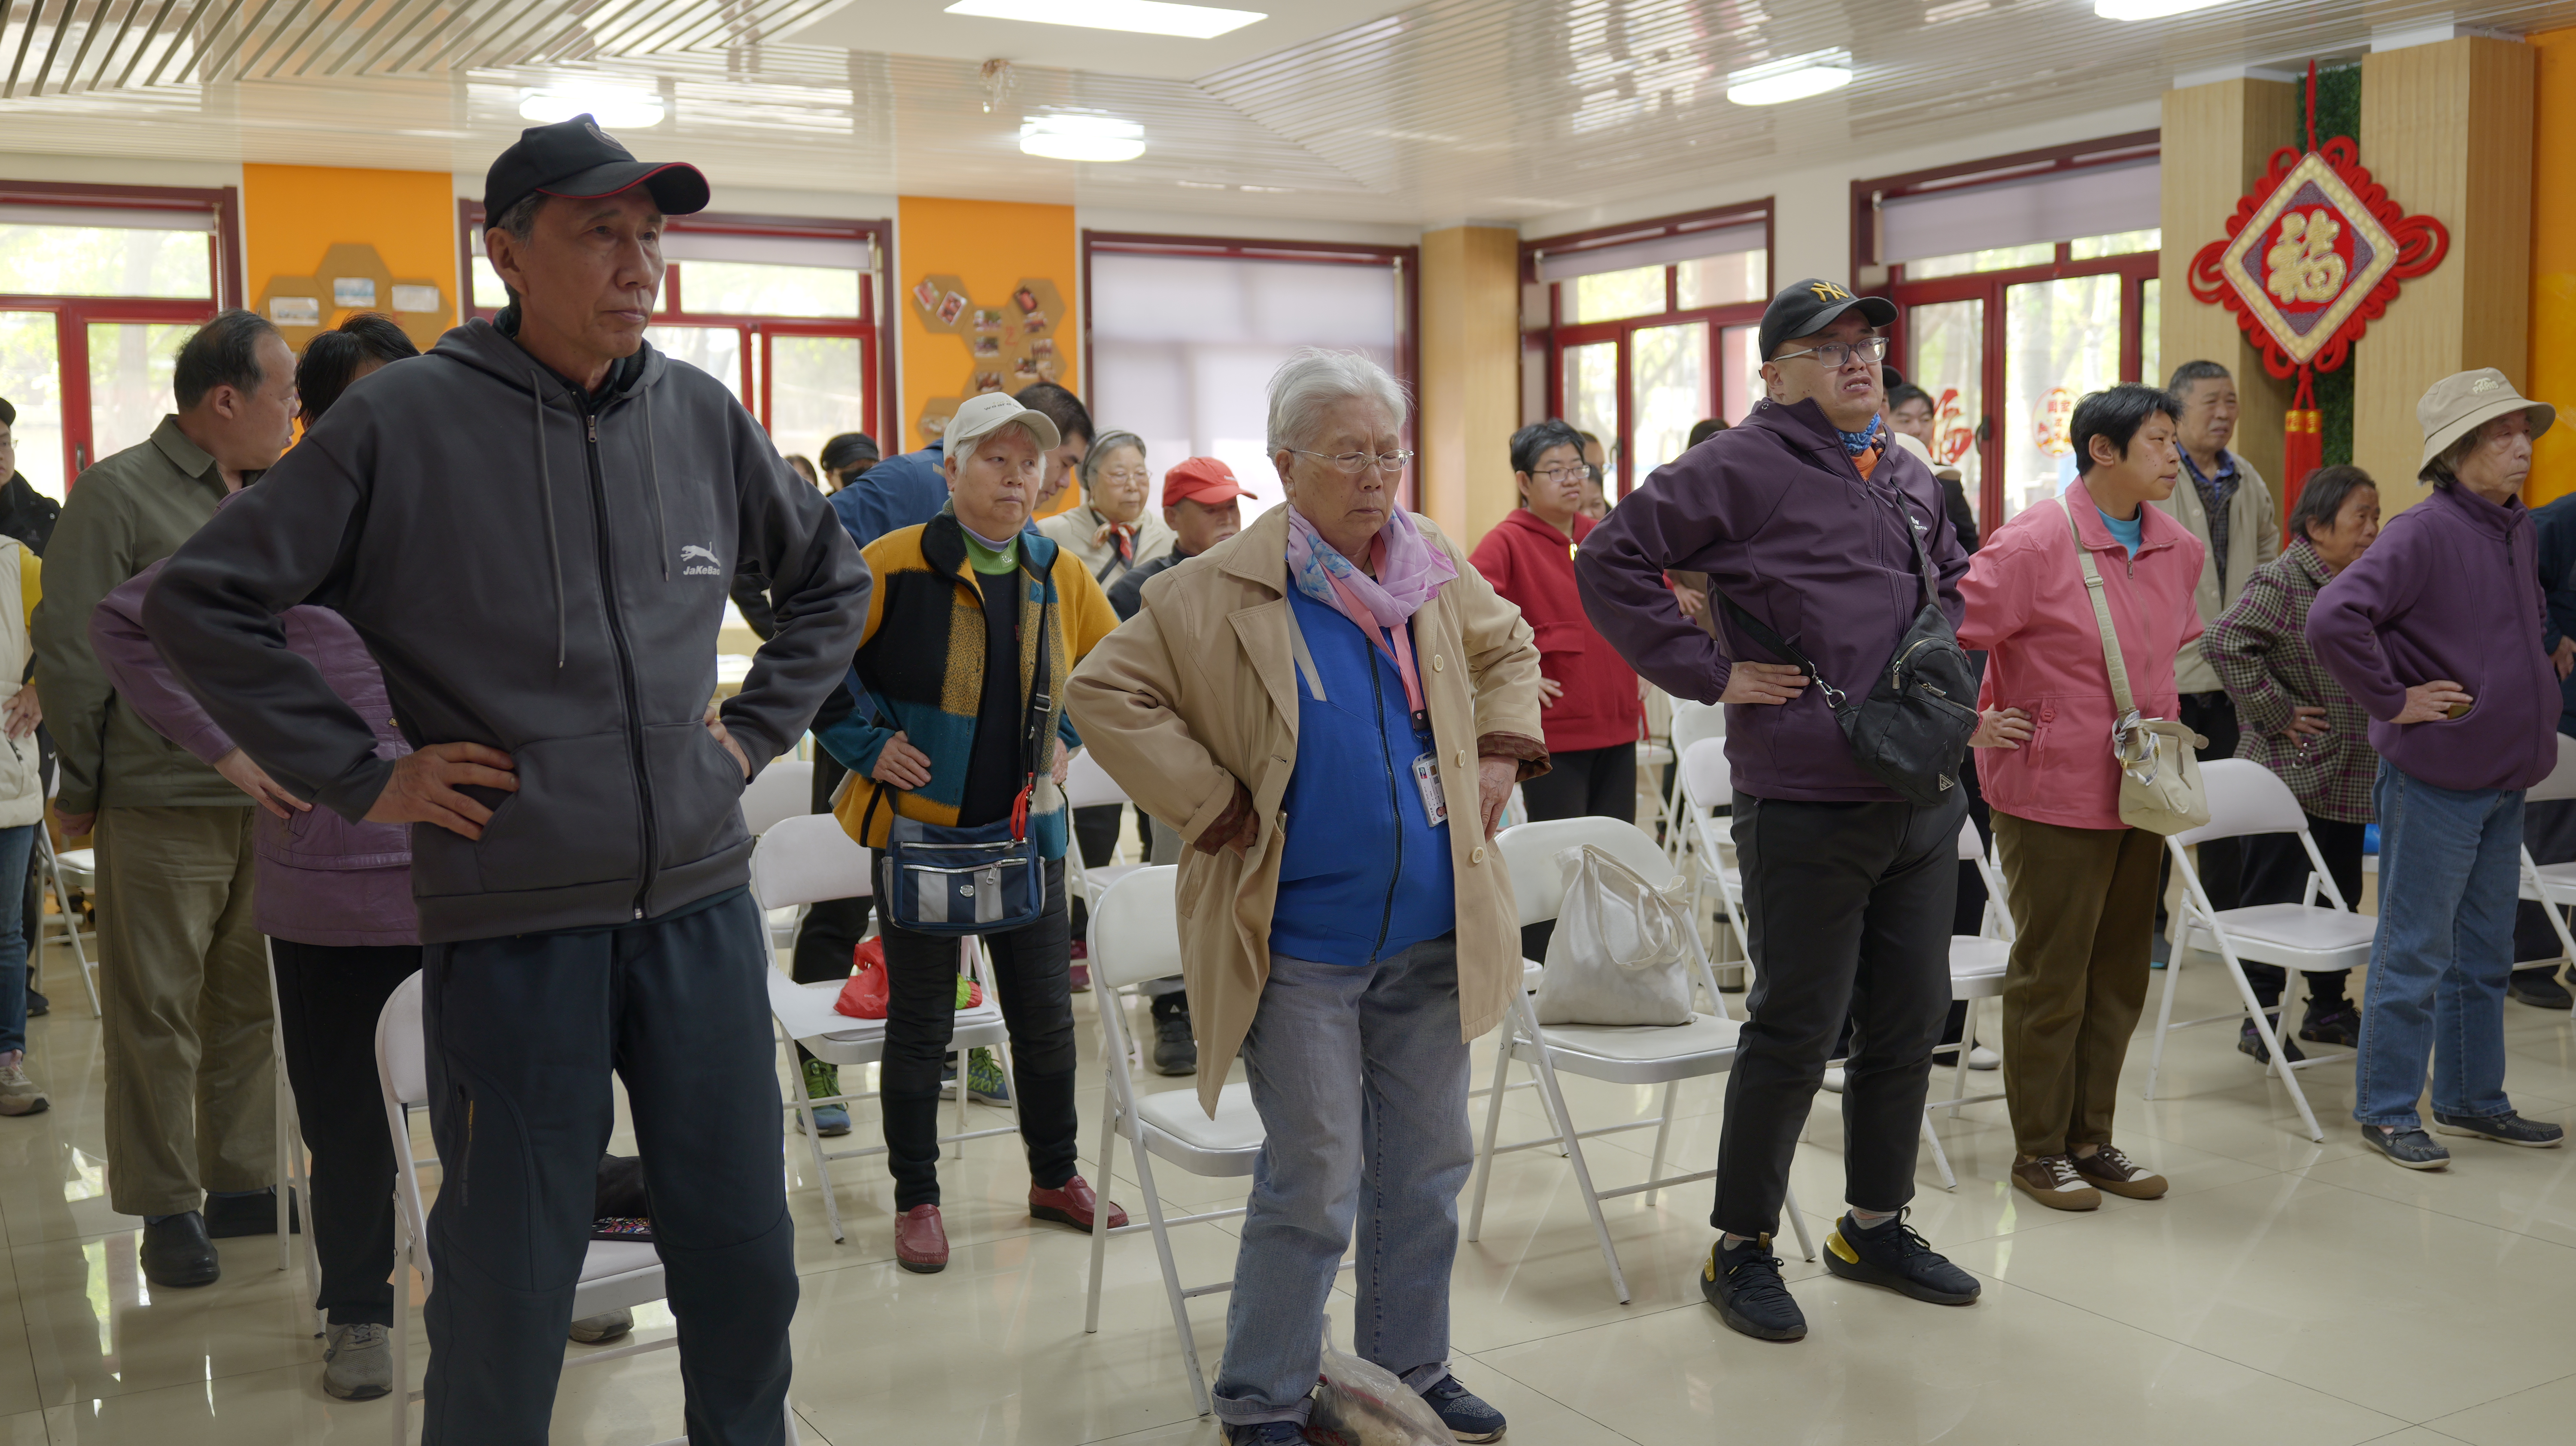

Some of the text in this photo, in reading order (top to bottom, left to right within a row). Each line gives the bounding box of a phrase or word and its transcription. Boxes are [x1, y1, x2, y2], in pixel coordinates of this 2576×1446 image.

[2267, 209, 2347, 304] 福
[2473, 381, 2499, 394] PARIS
[683, 565, 720, 575] JaKeBao
